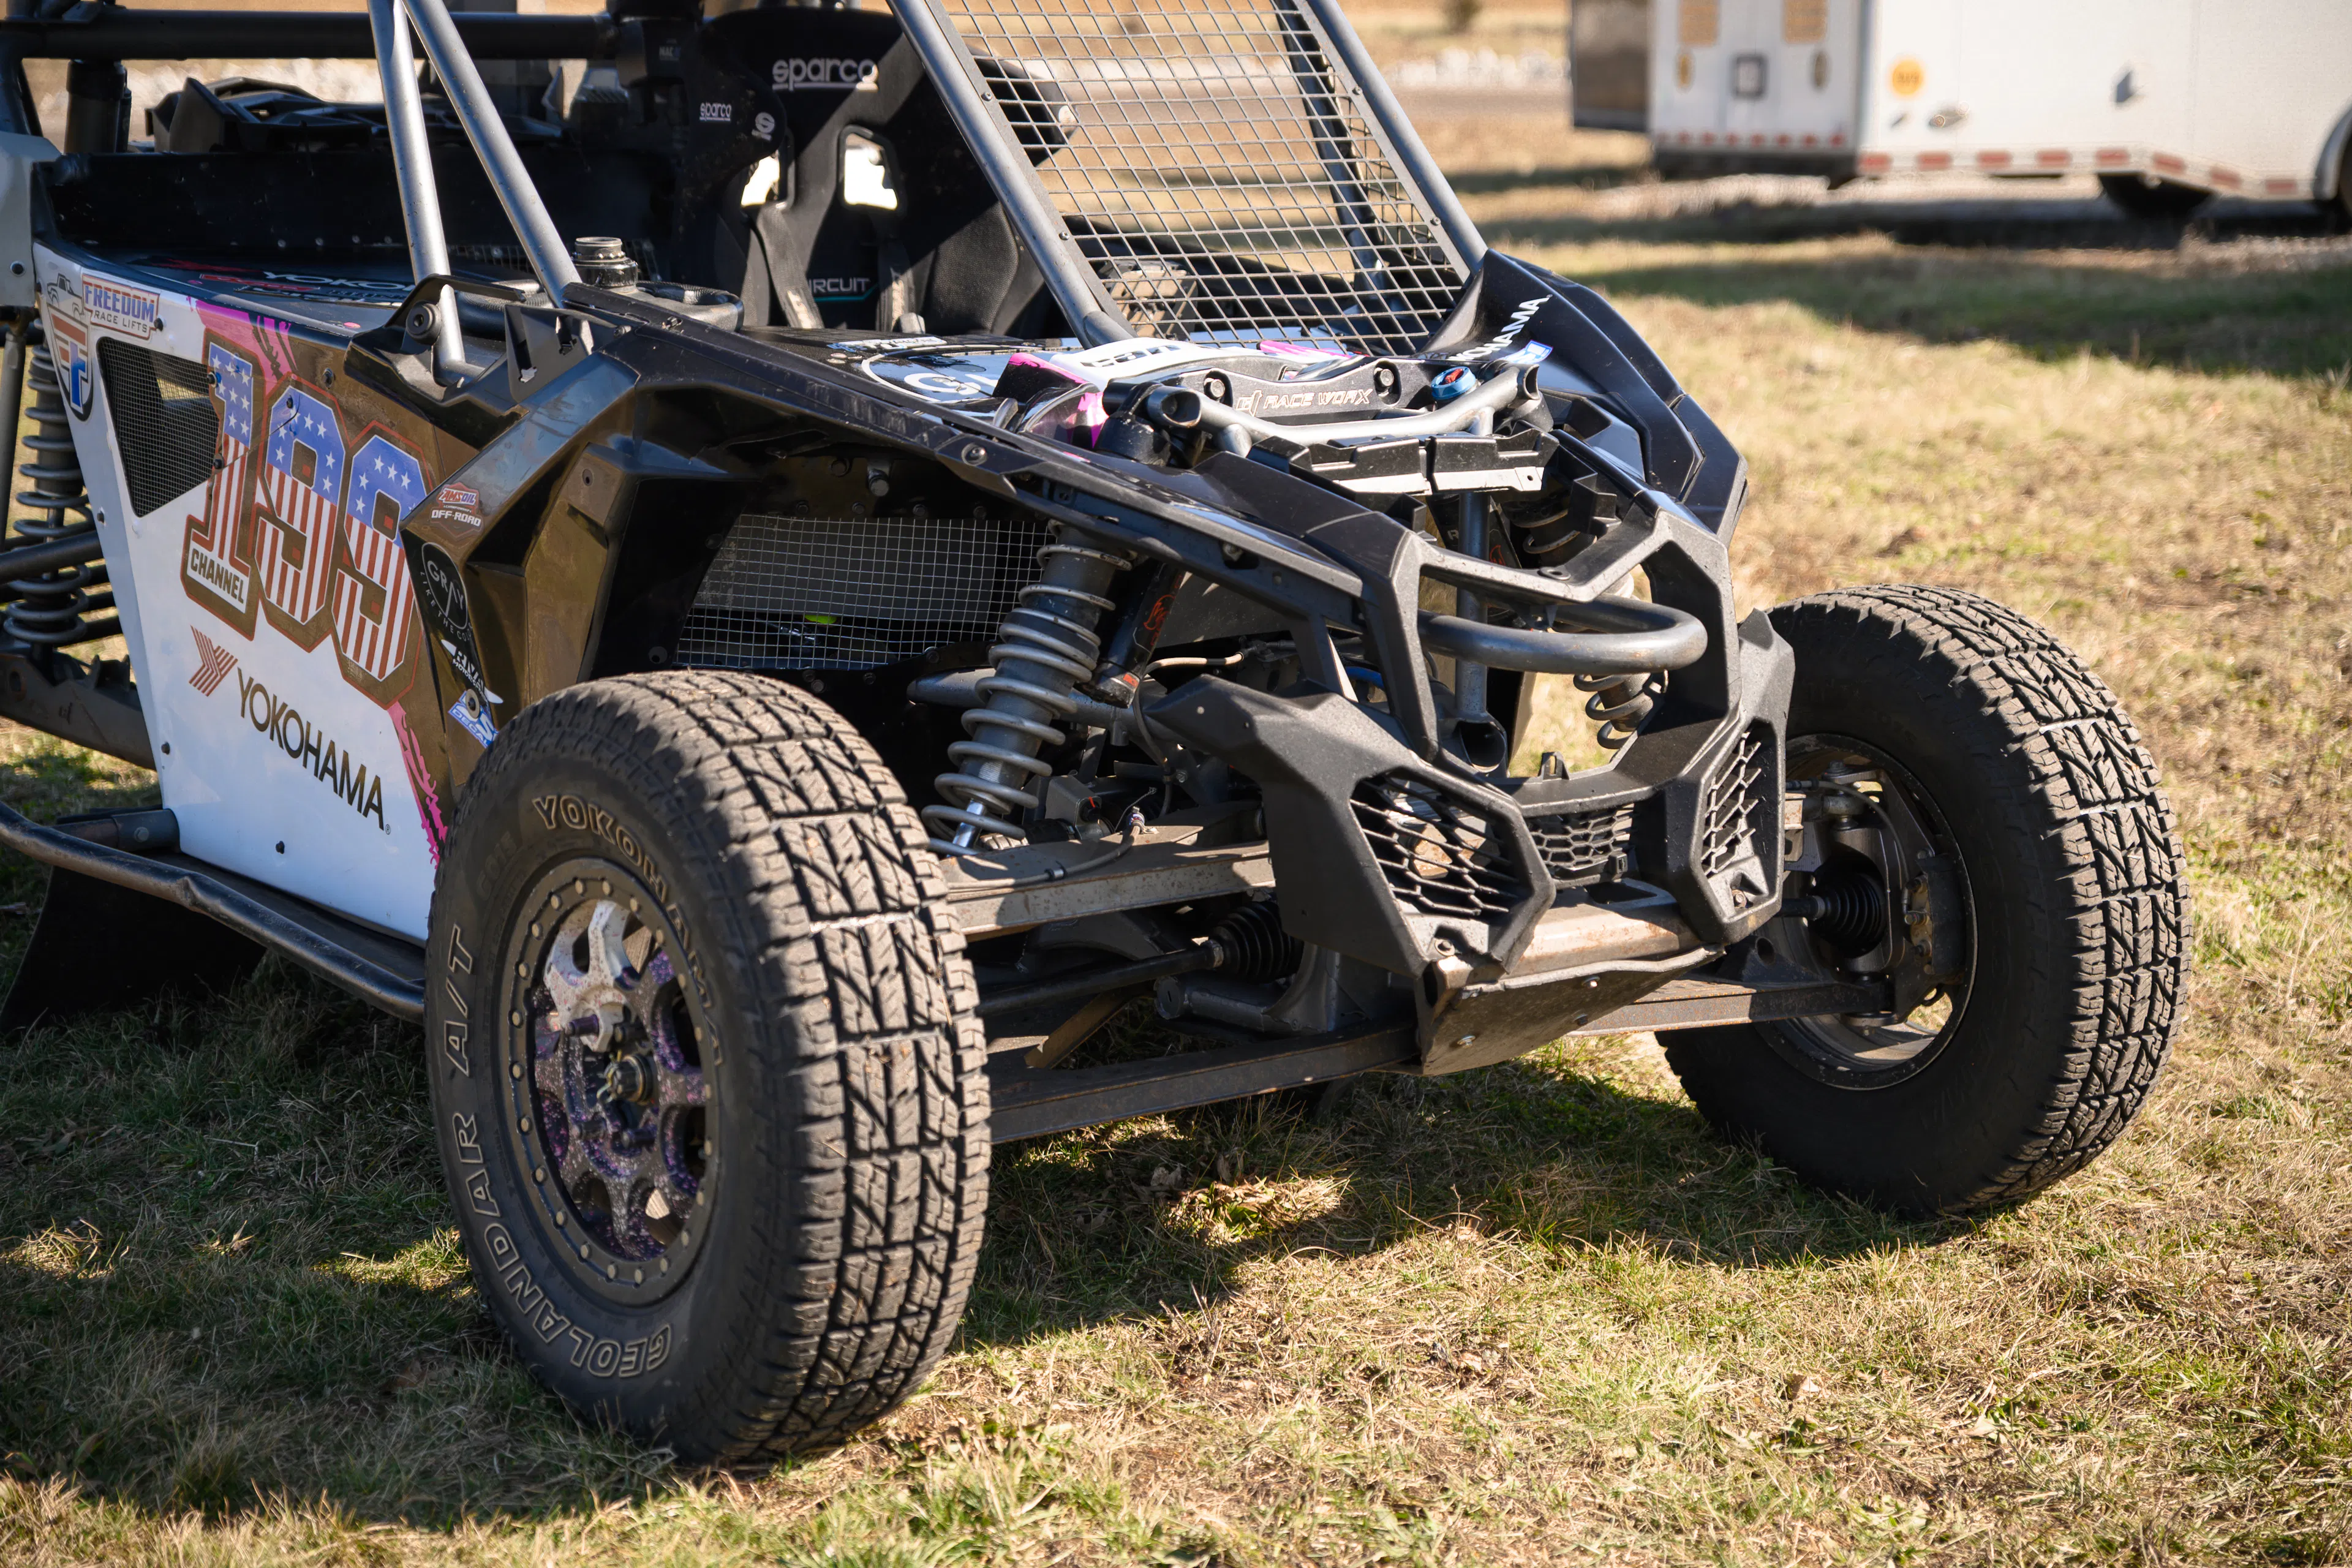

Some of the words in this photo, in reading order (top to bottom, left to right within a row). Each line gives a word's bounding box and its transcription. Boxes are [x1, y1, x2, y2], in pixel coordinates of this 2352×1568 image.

[772, 58, 878, 91] sparco
[699, 102, 732, 122] sparco
[263, 271, 415, 292] YOKO
[809, 277, 870, 292] IRCUIT
[83, 281, 155, 323] FREEDOM
[94, 310, 118, 325] RACE
[123, 317, 148, 333] LIFTS
[1263, 391, 1315, 410] RACE
[1318, 388, 1373, 405] WORX
[191, 342, 428, 682] 199
[439, 489, 477, 505] AMSOIL
[190, 548, 245, 604] CHANNEL
[427, 560, 464, 617] GRAY
[437, 610, 454, 634] THE
[237, 666, 385, 832] YOKOHAMA
[532, 794, 723, 1066] YOKOHAMA
[443, 923, 473, 1078] A/T
[452, 1112, 671, 1378] GEOLANDAR
